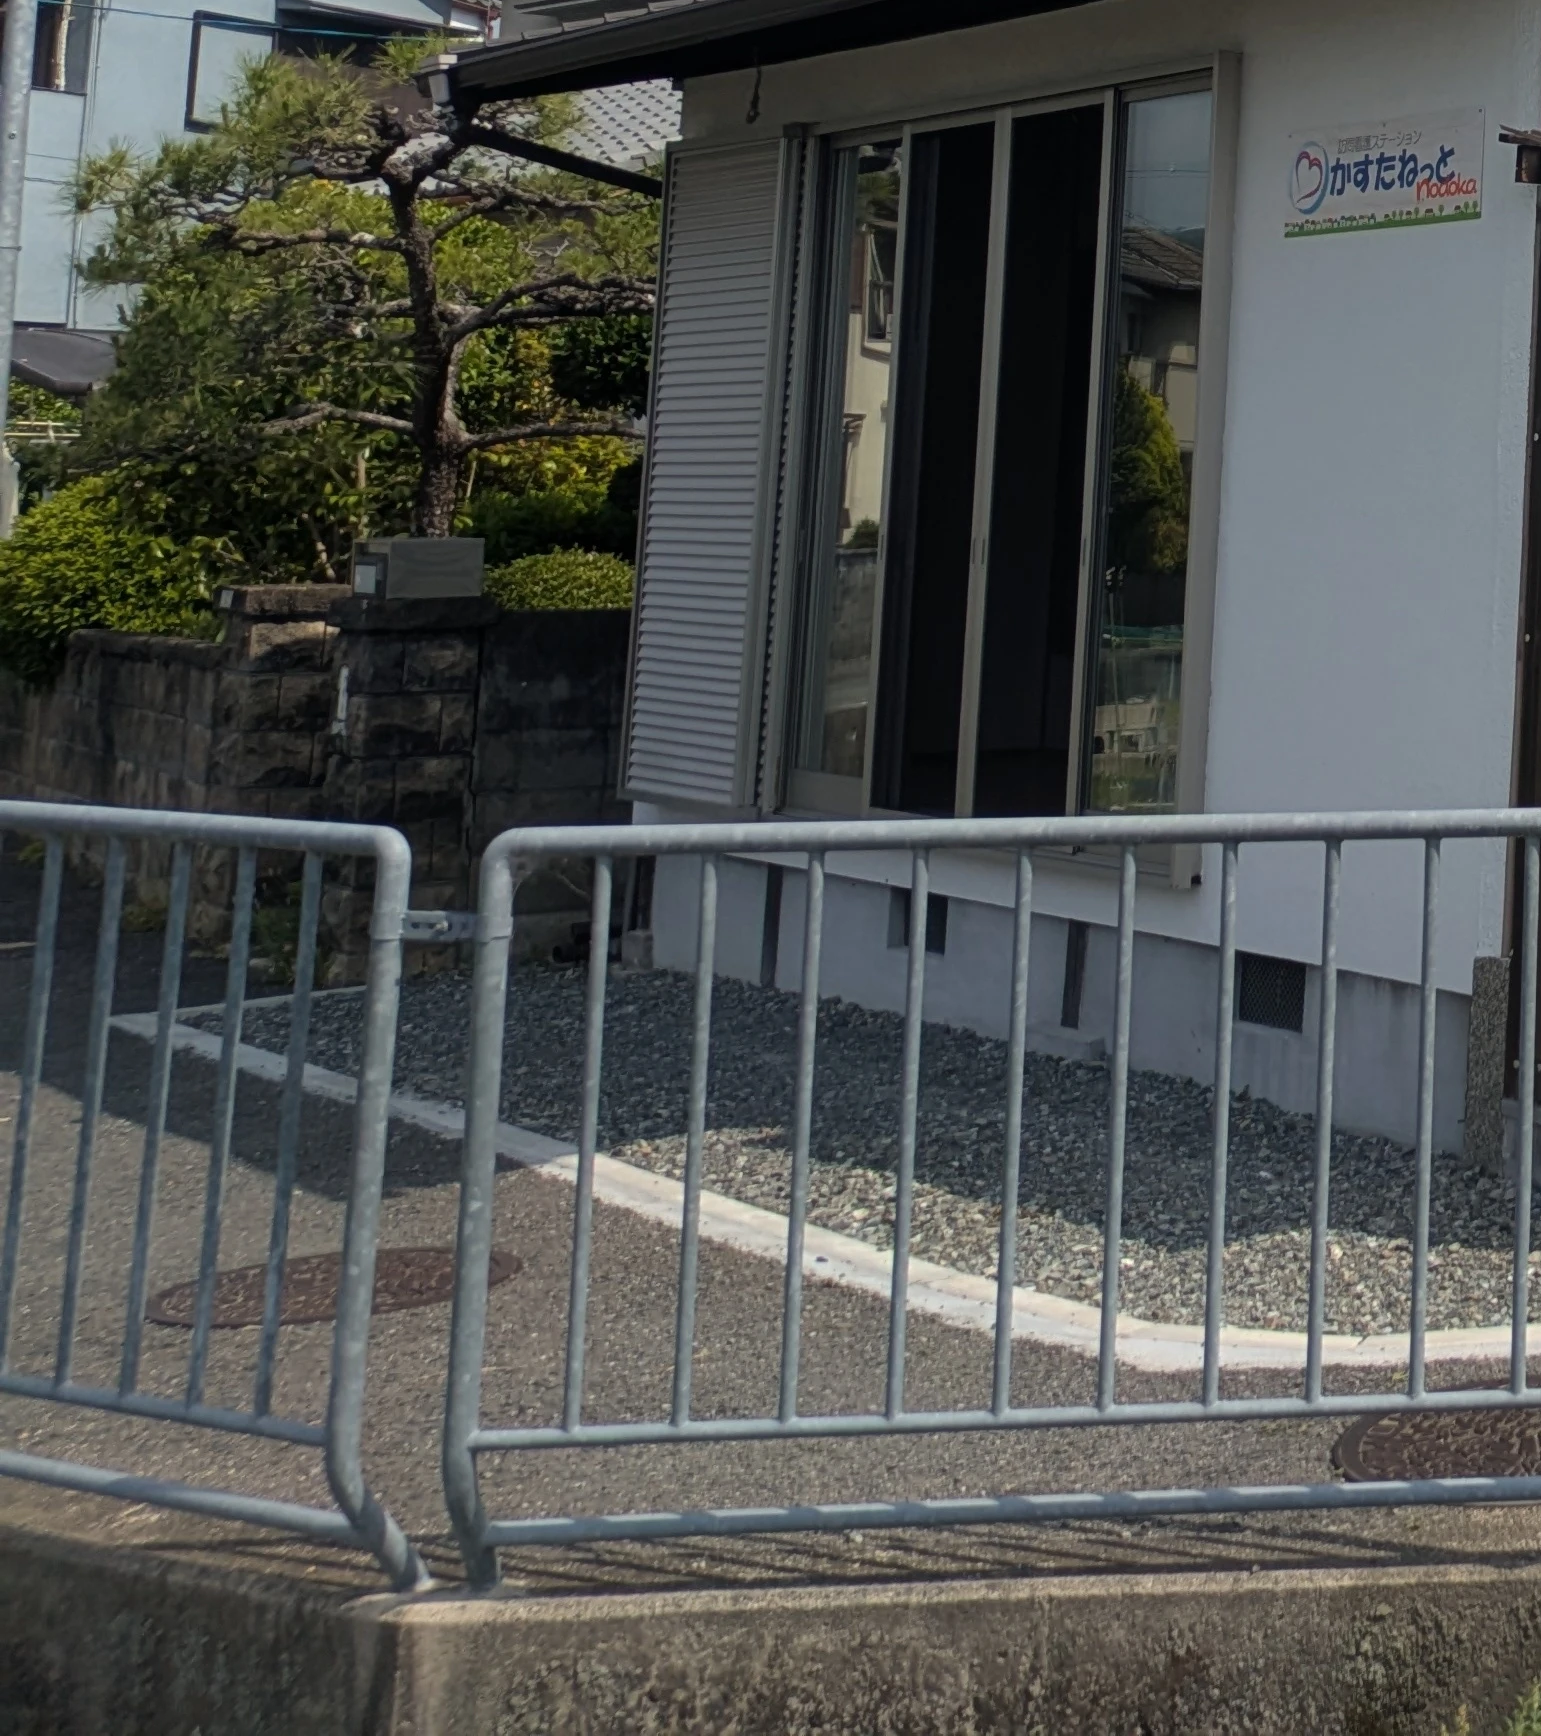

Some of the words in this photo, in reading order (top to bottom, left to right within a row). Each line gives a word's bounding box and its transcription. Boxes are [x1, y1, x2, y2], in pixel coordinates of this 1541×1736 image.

[1330, 144, 1456, 197] かすたねっと
